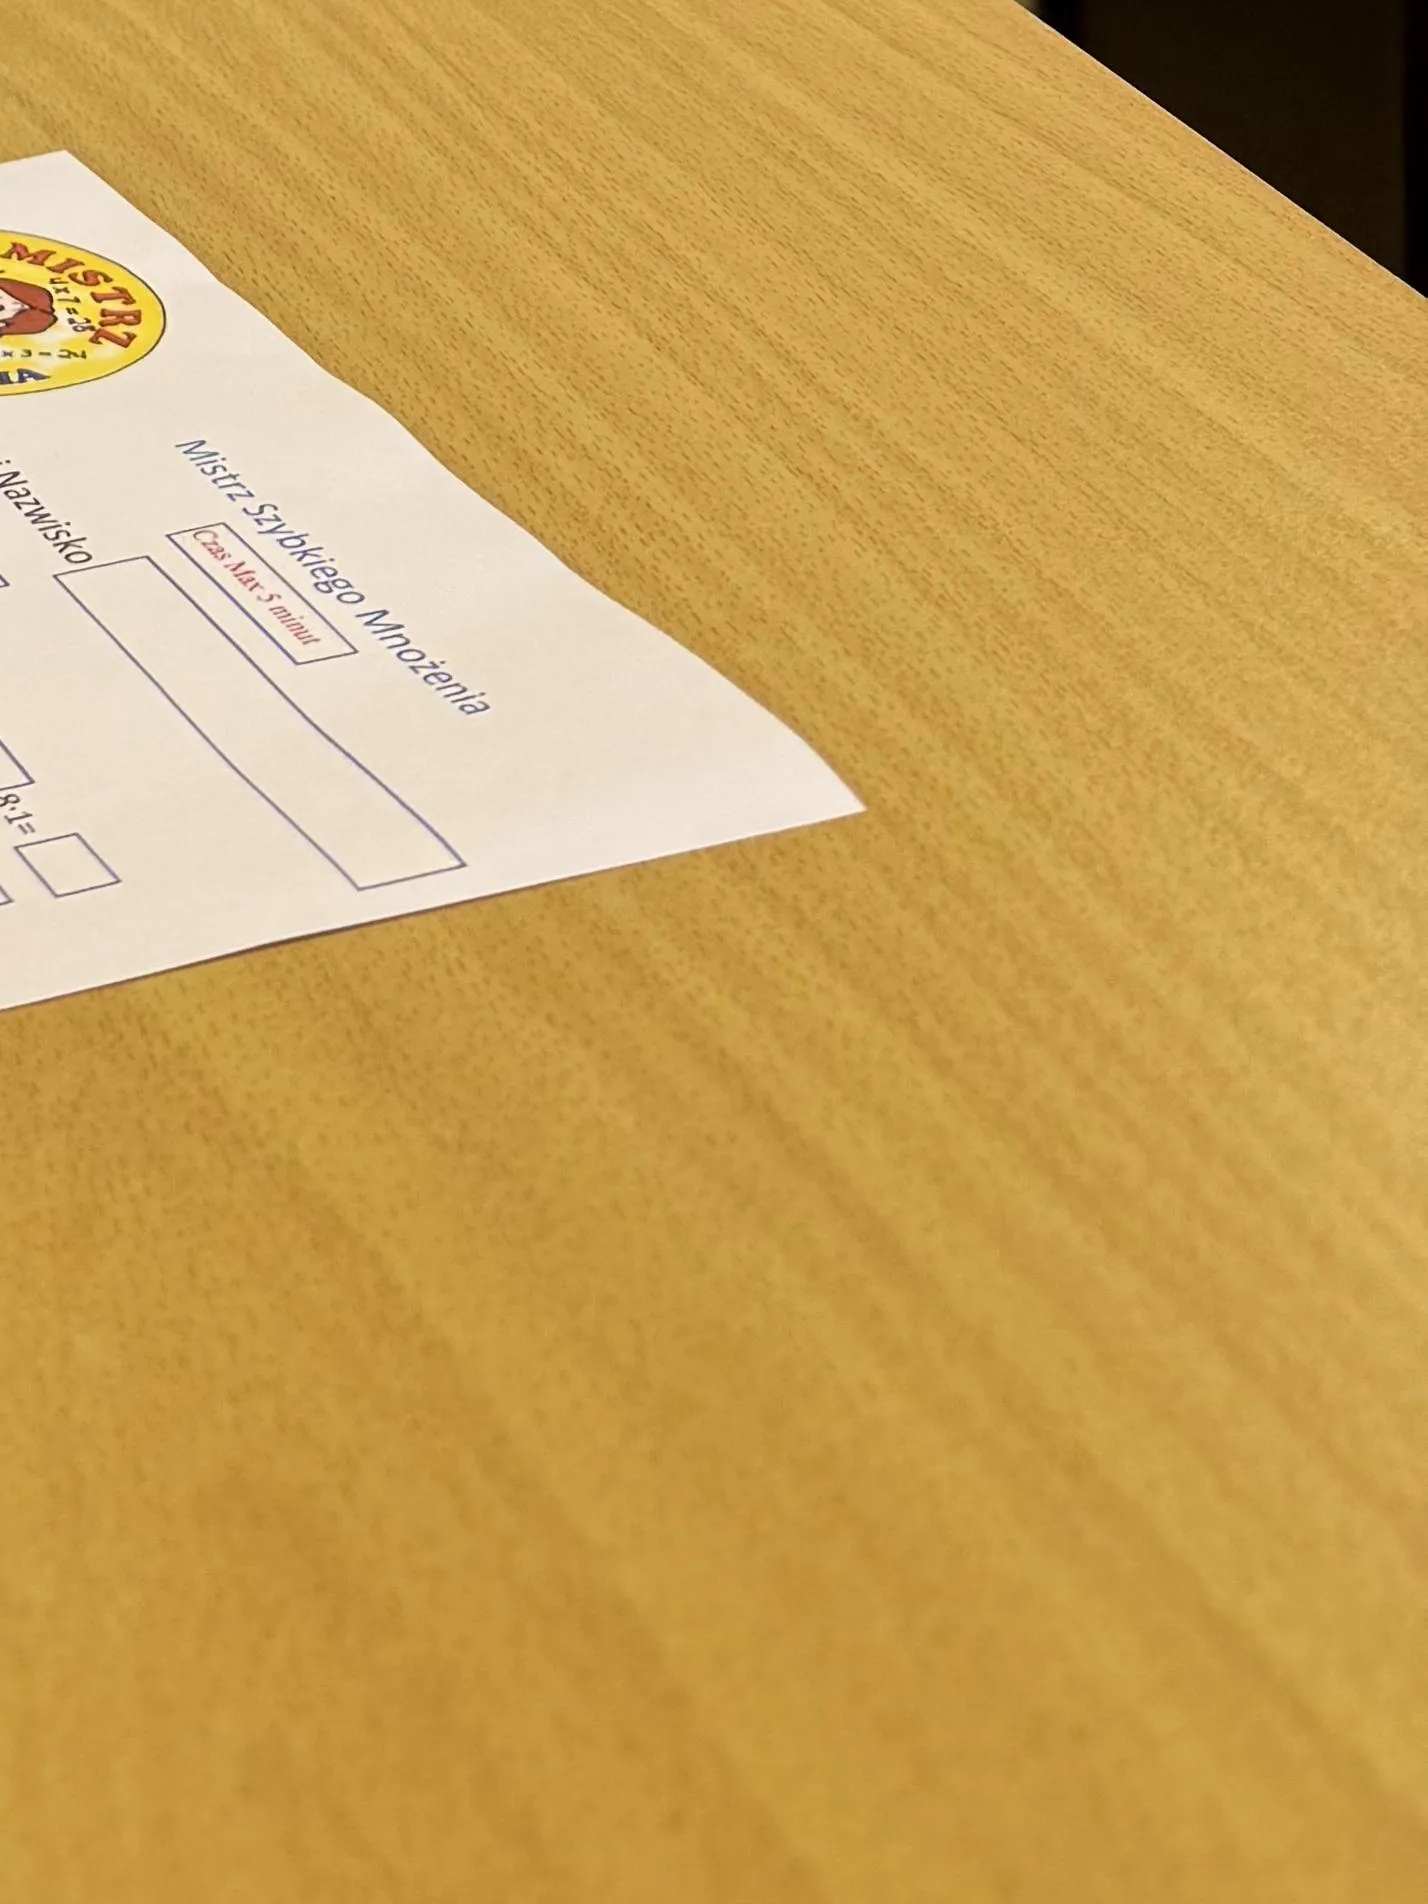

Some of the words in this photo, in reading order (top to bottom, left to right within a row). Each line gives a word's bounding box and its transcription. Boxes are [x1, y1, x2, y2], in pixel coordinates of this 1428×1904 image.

[192, 529, 231, 561] Czas
[175, 439, 255, 502] Mistrz
[241, 503, 365, 603] Szybkiego
[355, 609, 491, 716] Mnożenia
[224, 560, 264, 592] Max
[256, 593, 282, 603] 5
[268, 605, 321, 646] minut
